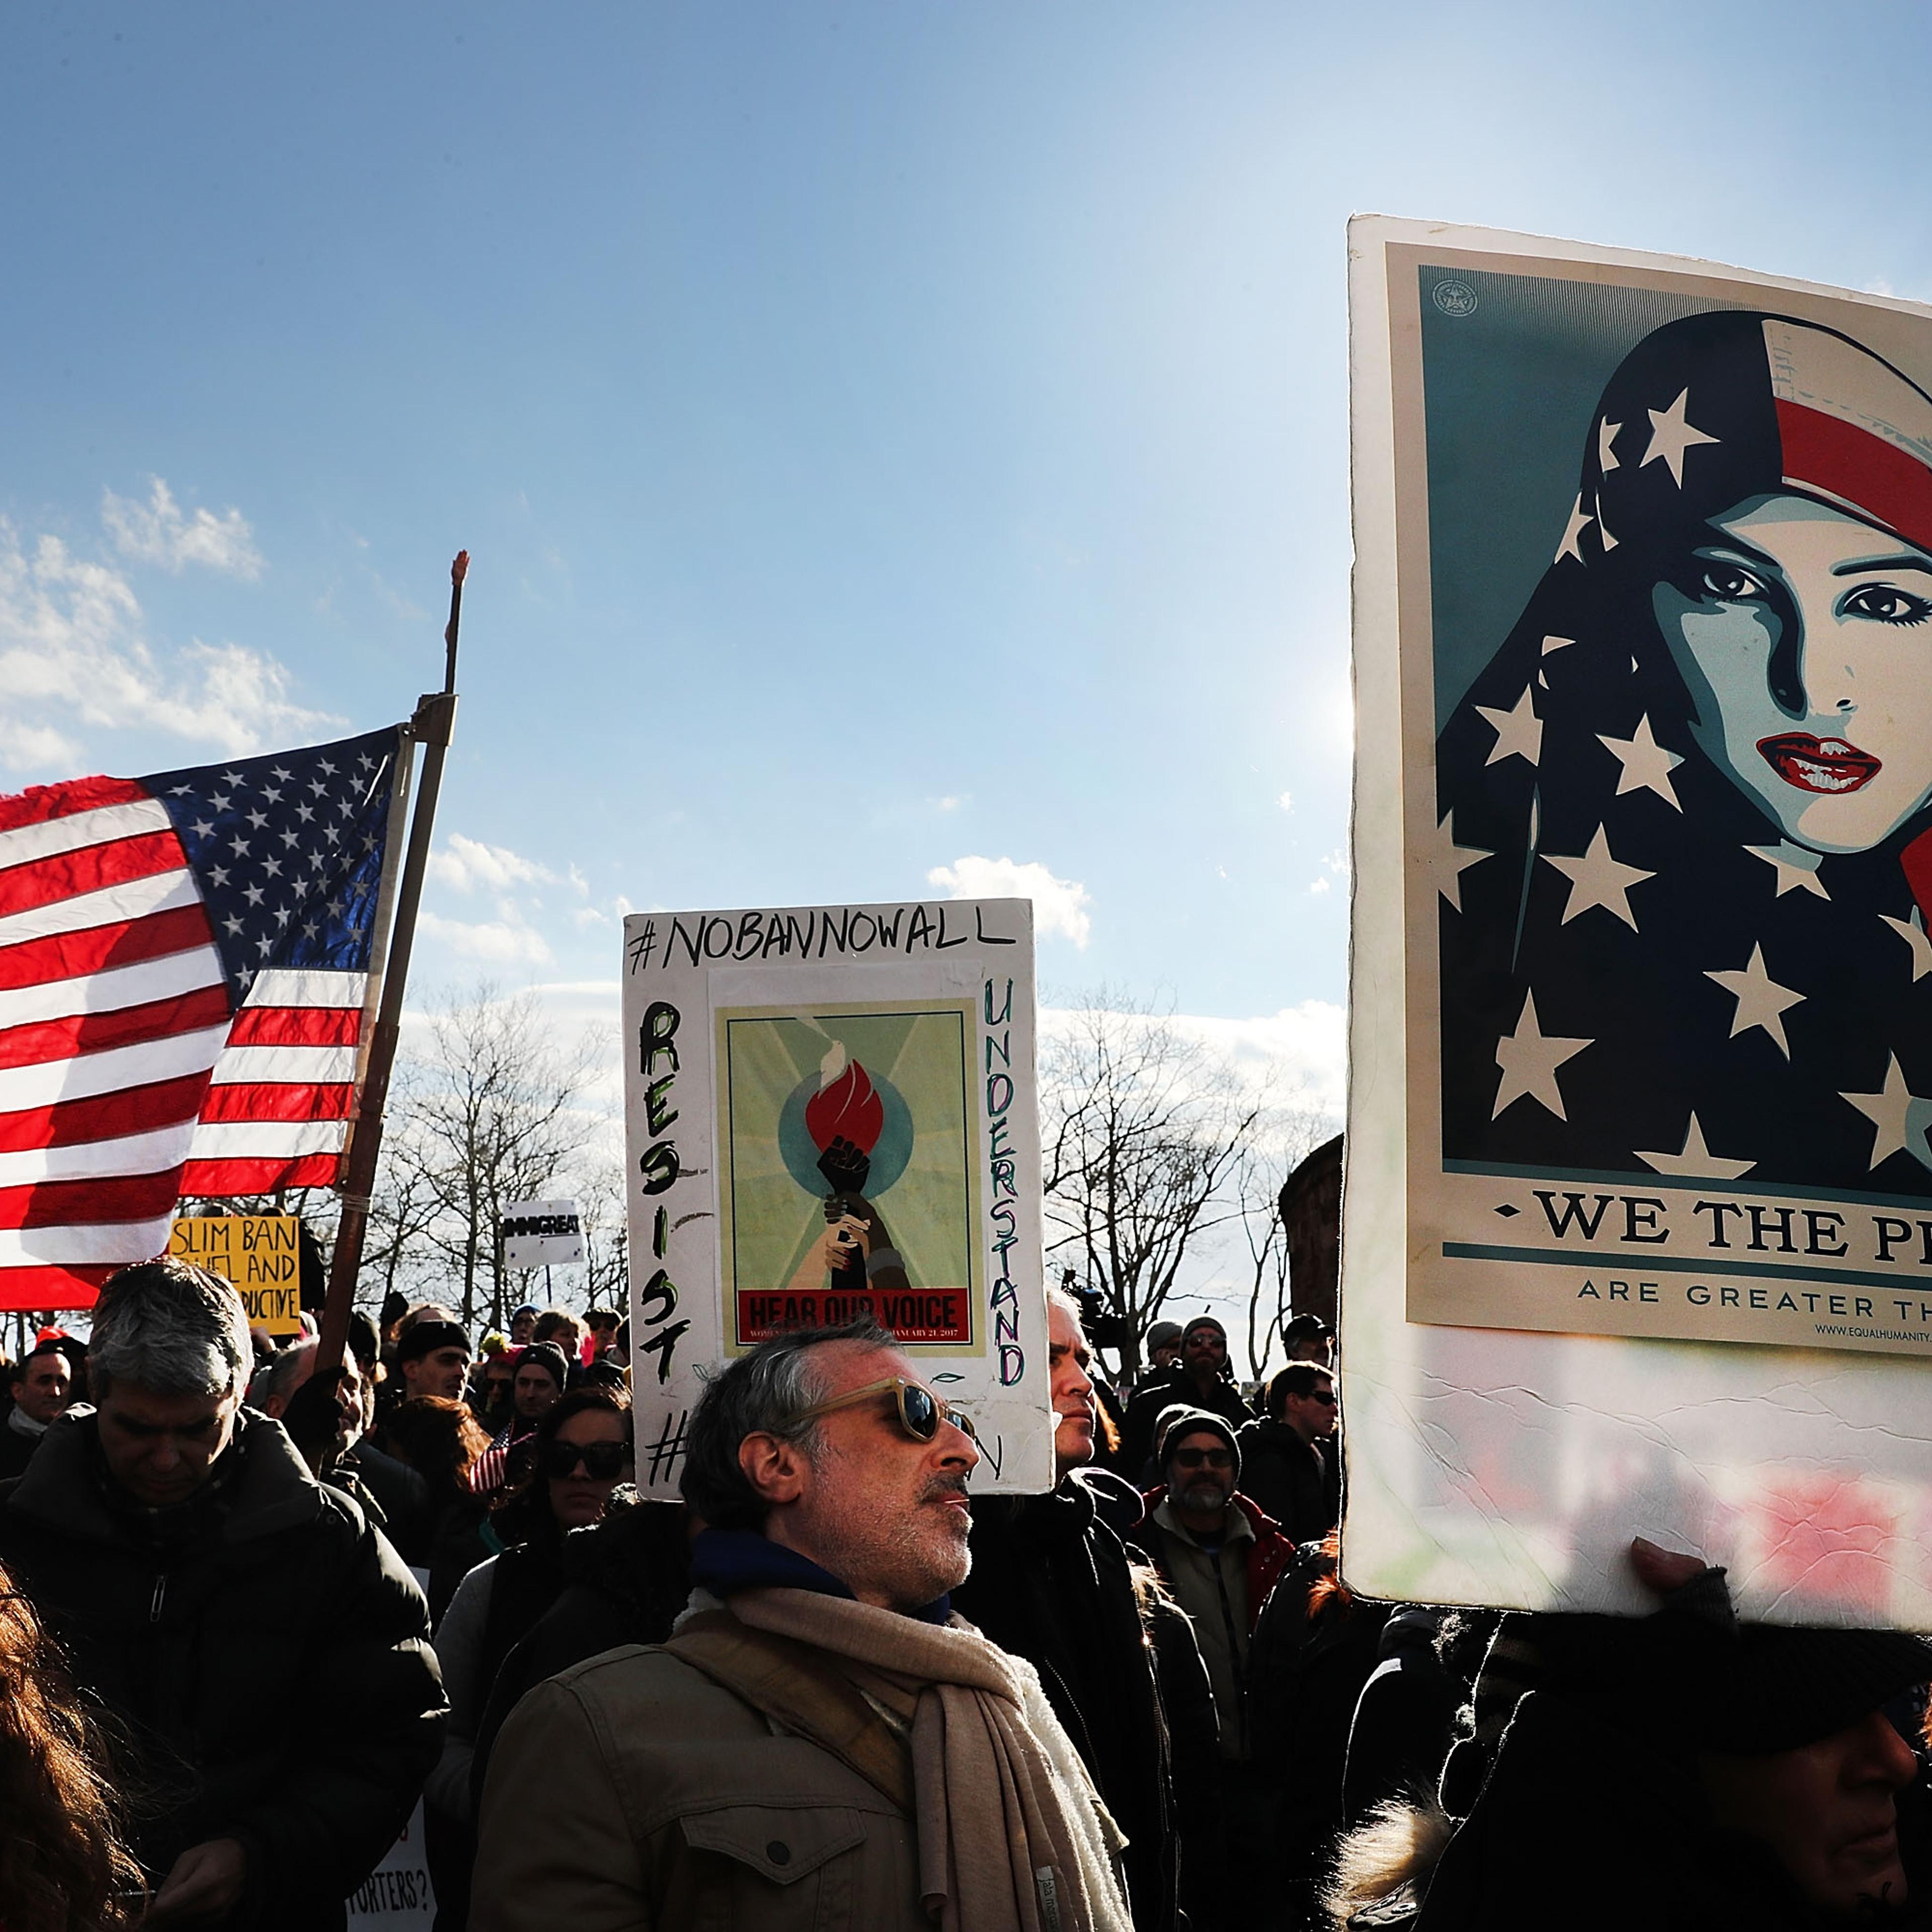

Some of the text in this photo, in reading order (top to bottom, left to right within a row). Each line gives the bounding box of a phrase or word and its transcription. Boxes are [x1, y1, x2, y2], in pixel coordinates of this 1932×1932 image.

[639, 1001, 691, 1385] RESIST
[984, 978, 1025, 1387] UNDERSTAND
[243, 1220, 295, 1252] BAN
[1533, 1190, 1670, 1244] WE
[1693, 1199, 1850, 1258] THE
[248, 1254, 295, 1283] AND
[750, 1295, 957, 1329] HEAR OUR VOICE
[1578, 1279, 1659, 1303] ARE
[1686, 1284, 1874, 1318] GREATER
